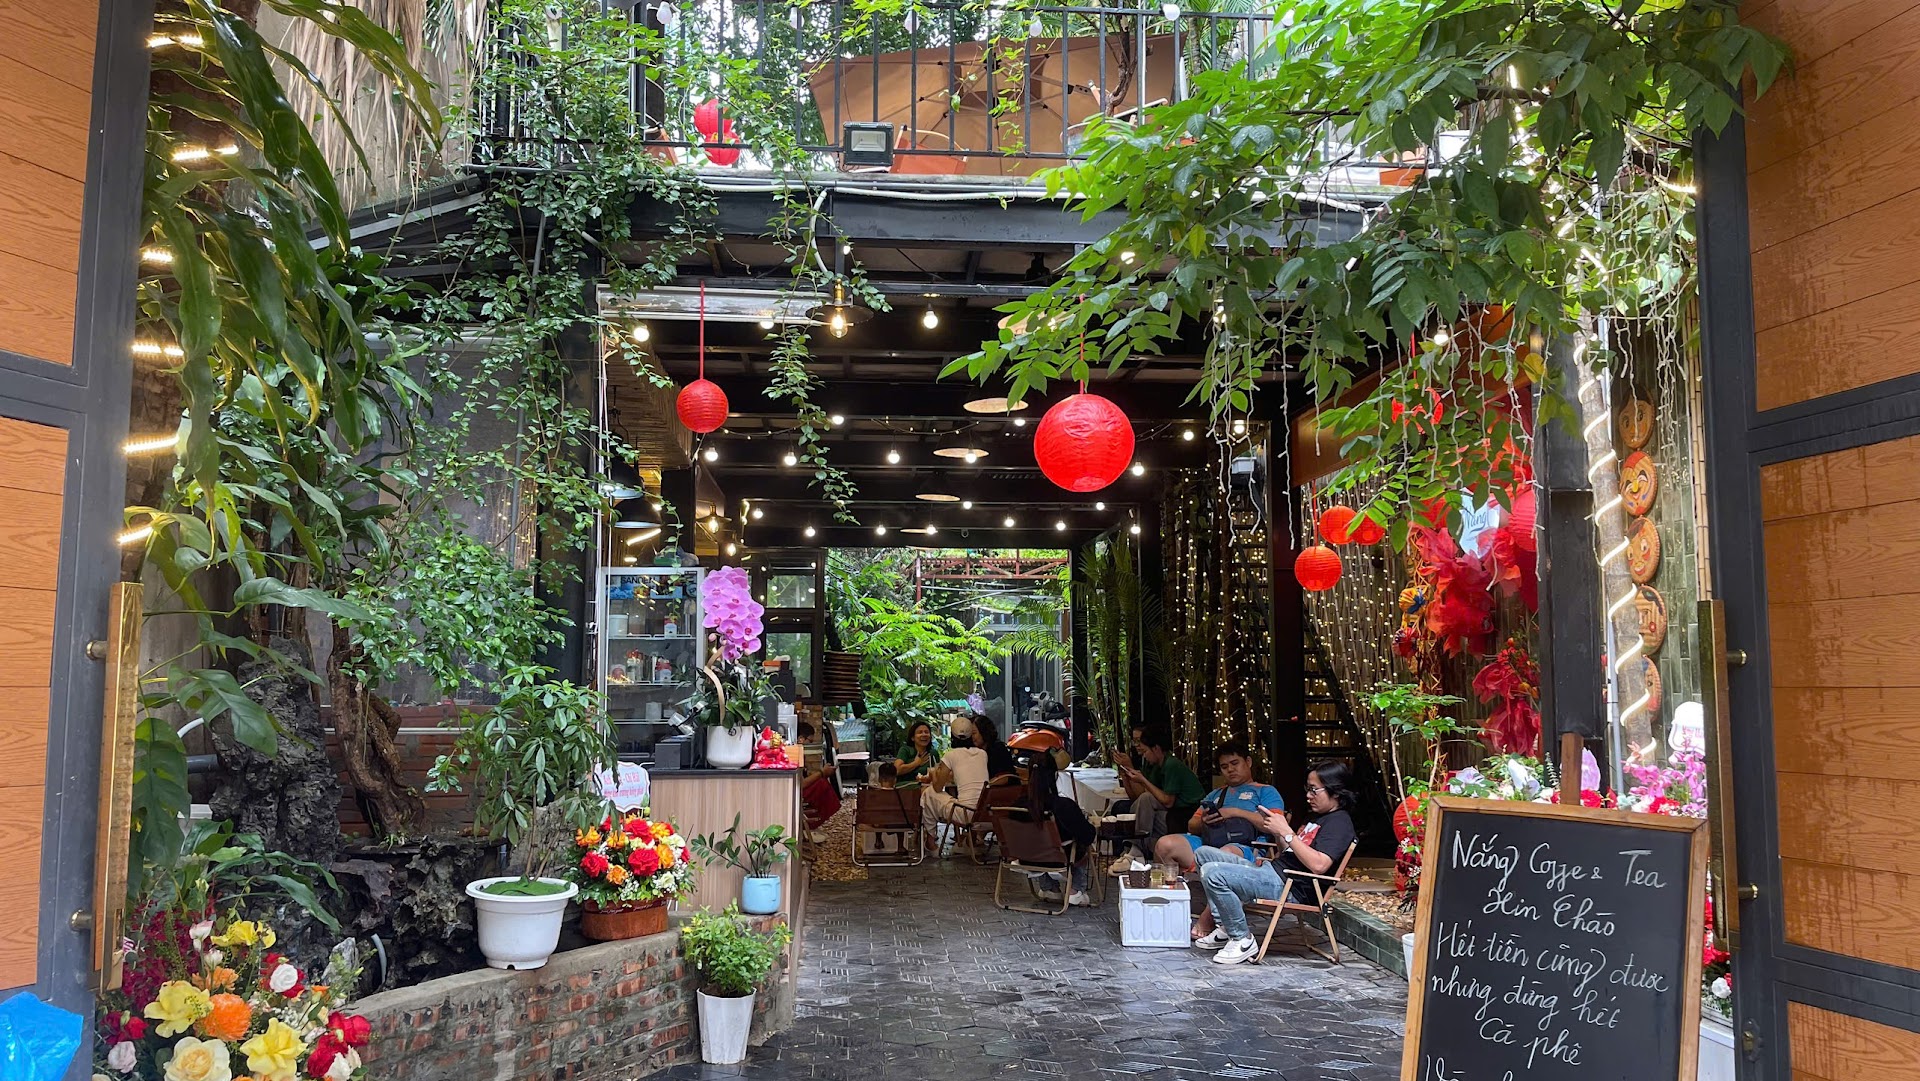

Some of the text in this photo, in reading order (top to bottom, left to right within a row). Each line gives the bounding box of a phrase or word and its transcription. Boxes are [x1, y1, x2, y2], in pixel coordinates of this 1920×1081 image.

[1452, 830, 1519, 892] Nắng
[1590, 866, 1603, 879] &
[1618, 849, 1667, 888] Tea
[1483, 887, 1616, 936] Xin Chào
[1436, 919, 1476, 960] Hết
[1431, 965, 1497, 1021] nhưng
[1571, 989, 1621, 1028] hết
[1523, 1029, 1582, 1069] phê
